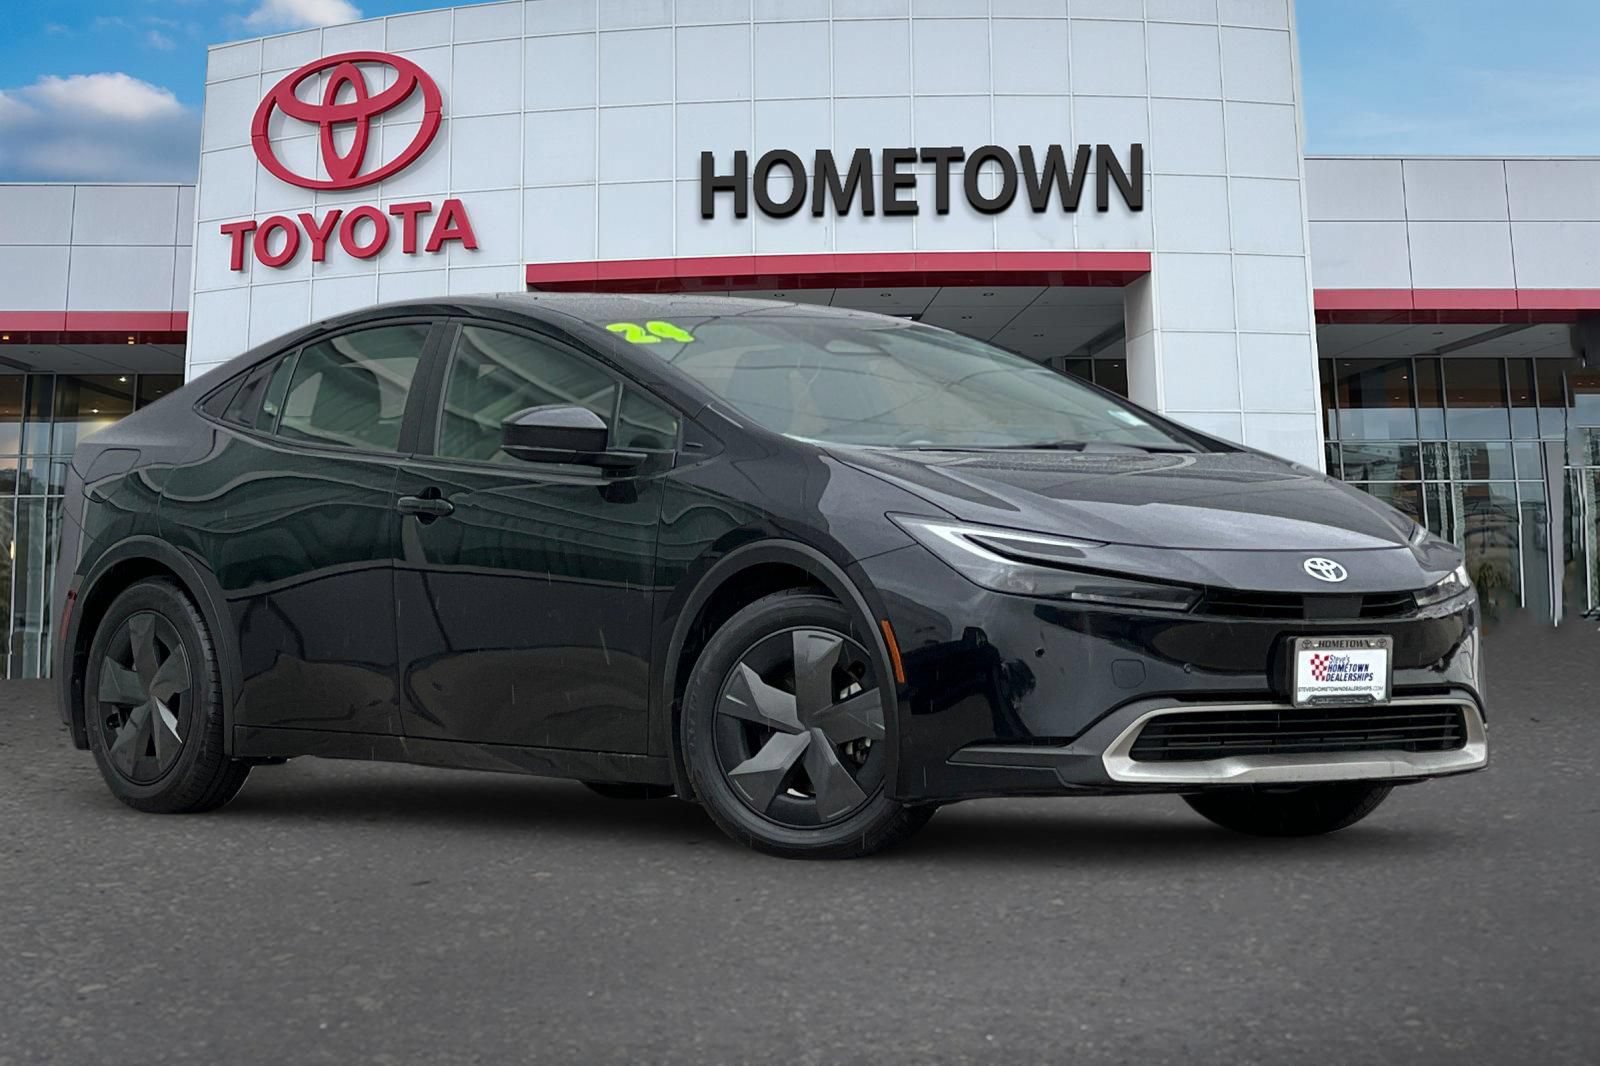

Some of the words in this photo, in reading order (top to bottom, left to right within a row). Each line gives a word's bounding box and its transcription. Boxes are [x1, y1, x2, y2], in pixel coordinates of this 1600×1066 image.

[700, 143, 1144, 219] HOMETOWN
[220, 198, 478, 271] TOYOTA
[1318, 640, 1371, 648] HOMETOWN
[1329, 654, 1350, 664] Steve's
[1327, 663, 1369, 672] HOMETOWN
[1326, 672, 1374, 681] DEALERSHIPS
